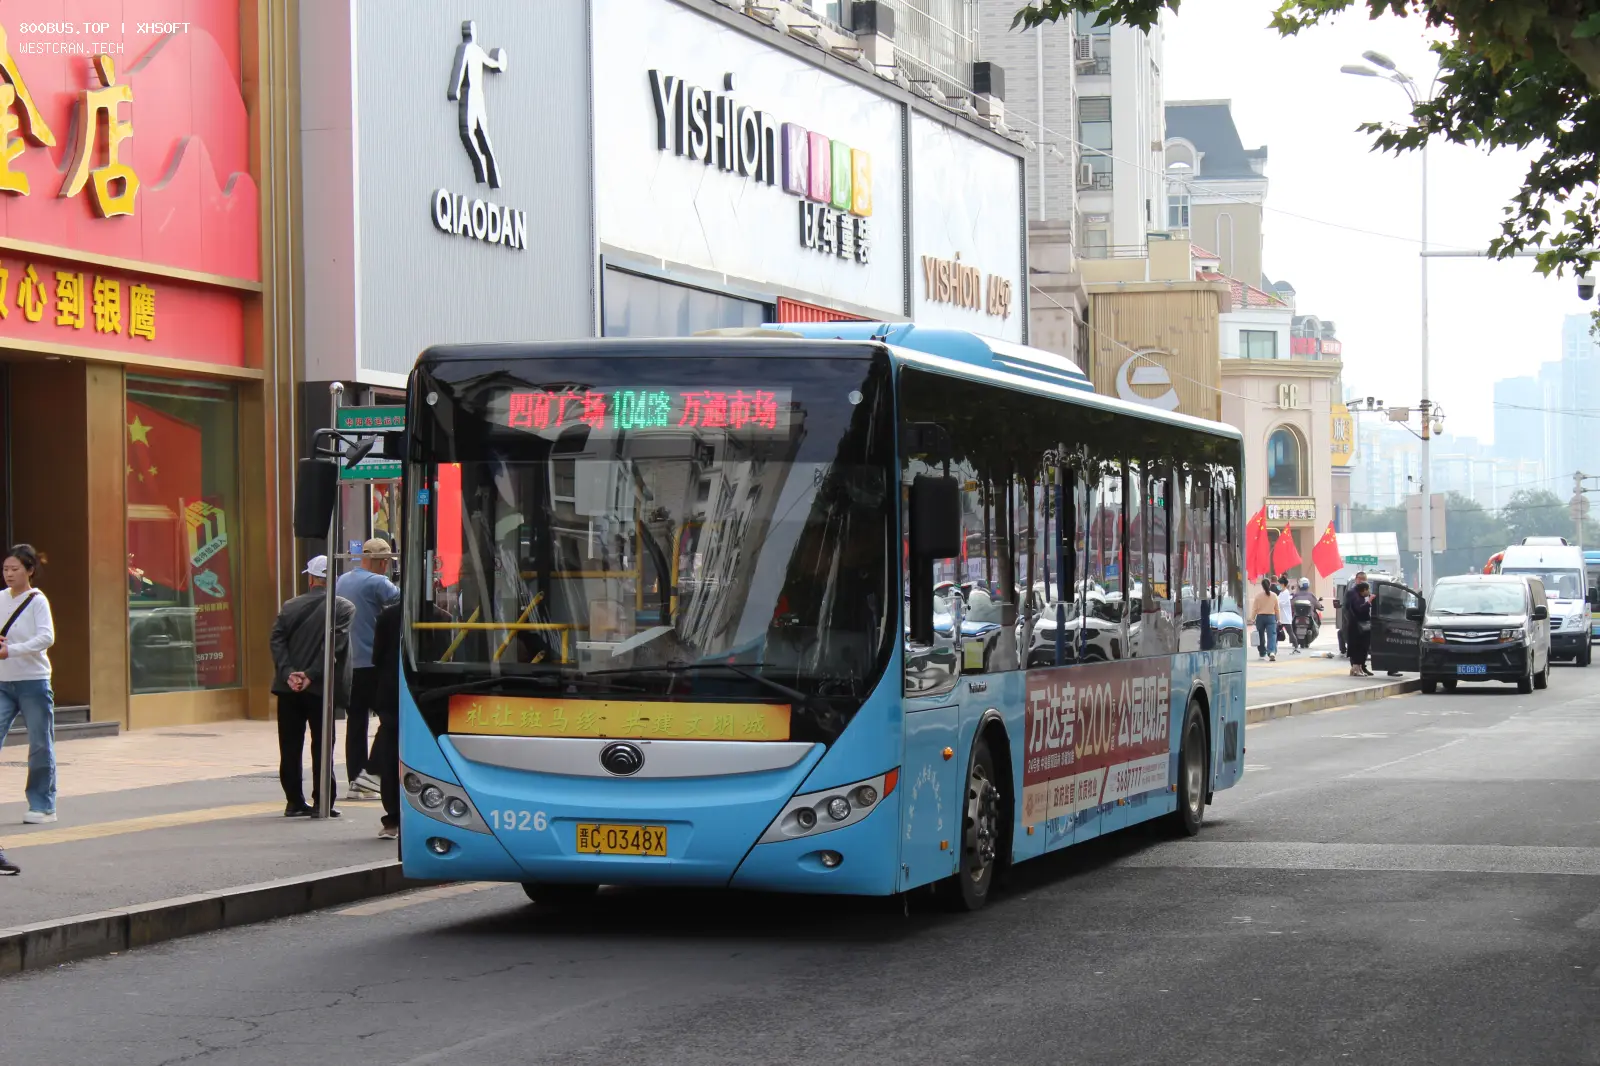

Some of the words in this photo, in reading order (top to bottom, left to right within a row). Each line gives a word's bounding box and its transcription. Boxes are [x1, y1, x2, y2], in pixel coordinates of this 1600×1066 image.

[783, 123, 872, 216] KIDS
[431, 188, 527, 250] QIAODAN
[800, 200, 872, 264] 以纯童装
[508, 390, 606, 430] 四矿广场
[613, 390, 672, 429] 104路
[678, 390, 778, 430] 万通市场
[465, 702, 600, 733] 礼让斑马线
[621, 711, 770, 738] 共建文明城
[1075, 682, 1112, 760] 5200
[1118, 673, 1169, 747] 公园现房
[490, 809, 548, 831] 1926
